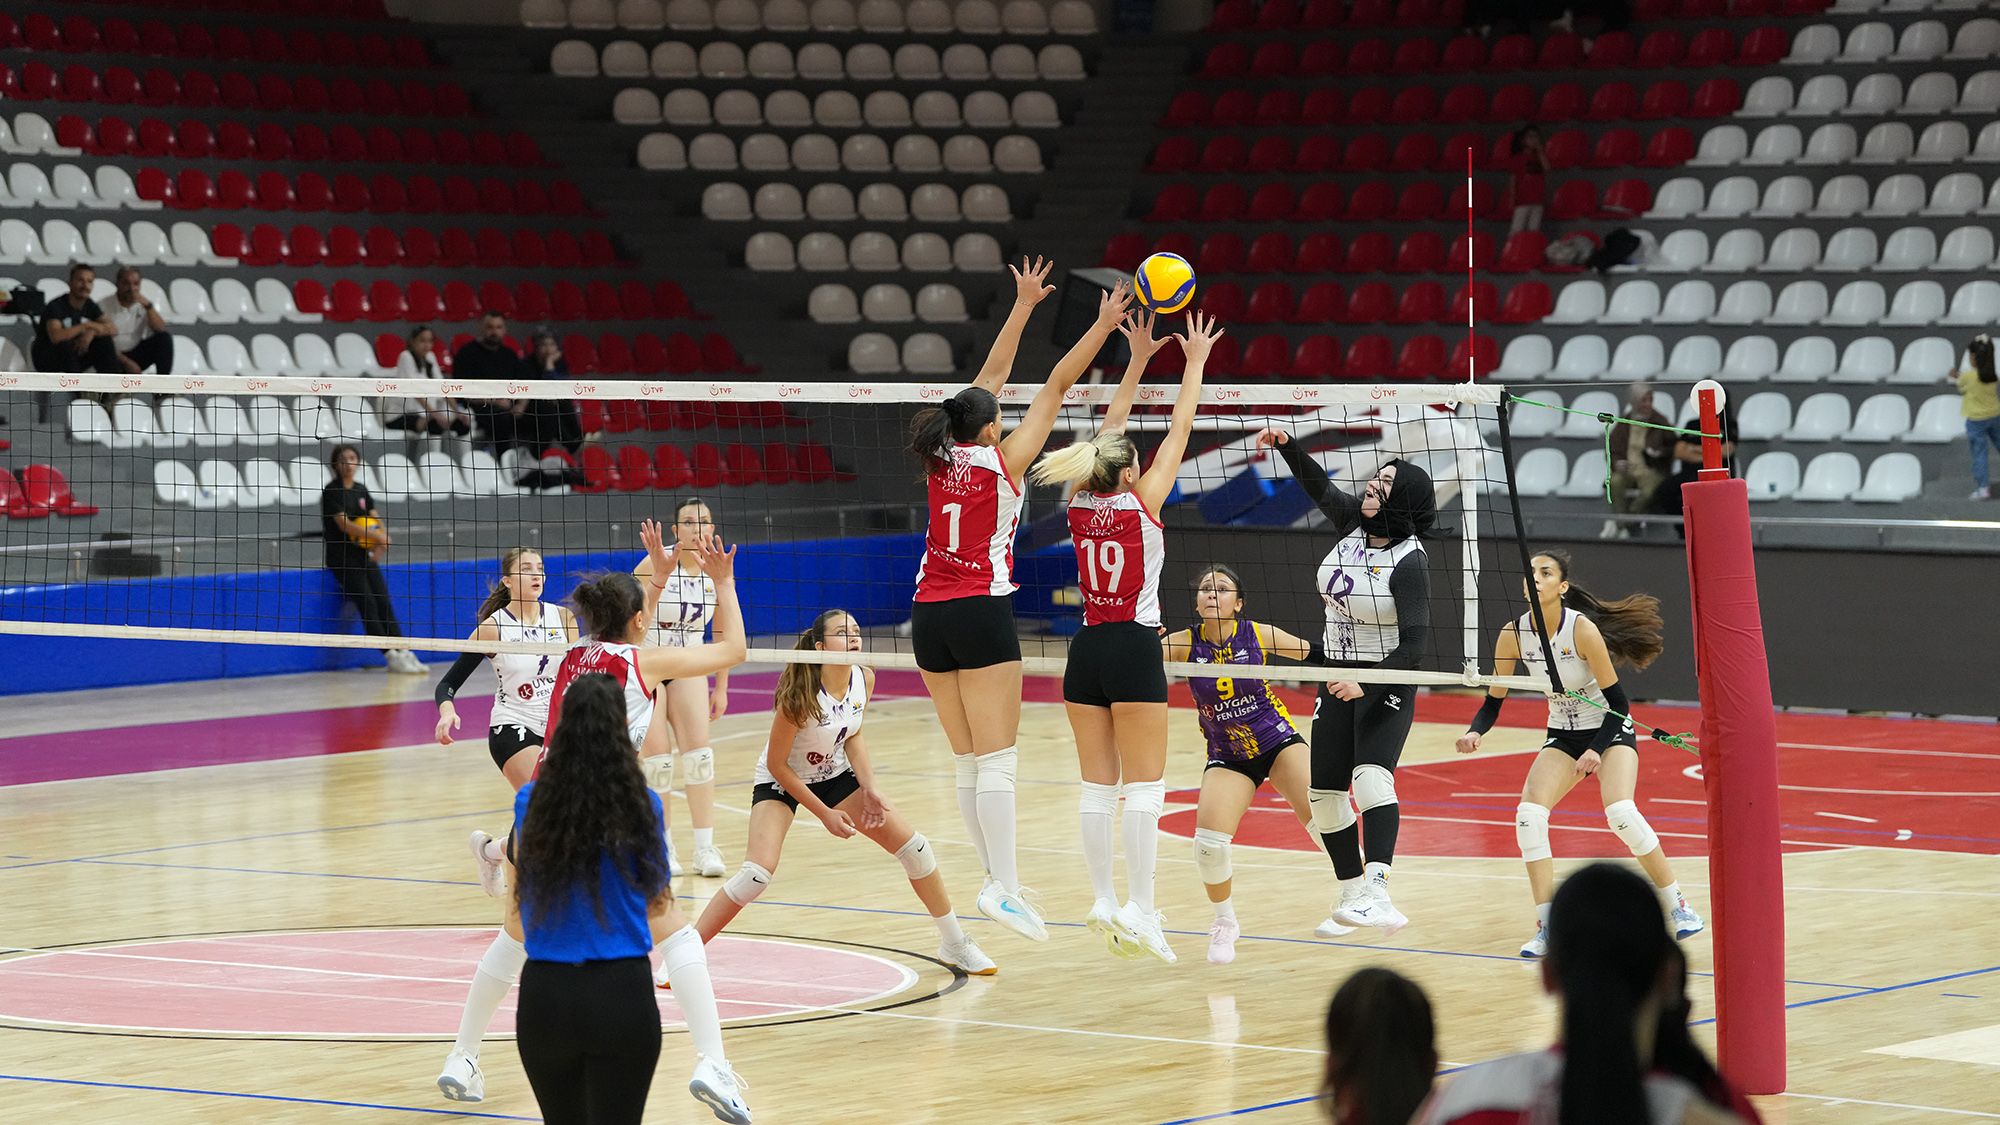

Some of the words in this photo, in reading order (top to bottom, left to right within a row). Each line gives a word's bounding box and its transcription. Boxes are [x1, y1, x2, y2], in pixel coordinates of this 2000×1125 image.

[942, 502, 962, 552] 1
[1081, 538, 1125, 593] 19
[1216, 677, 1235, 701] 9
[1216, 712, 1233, 722] FEN
